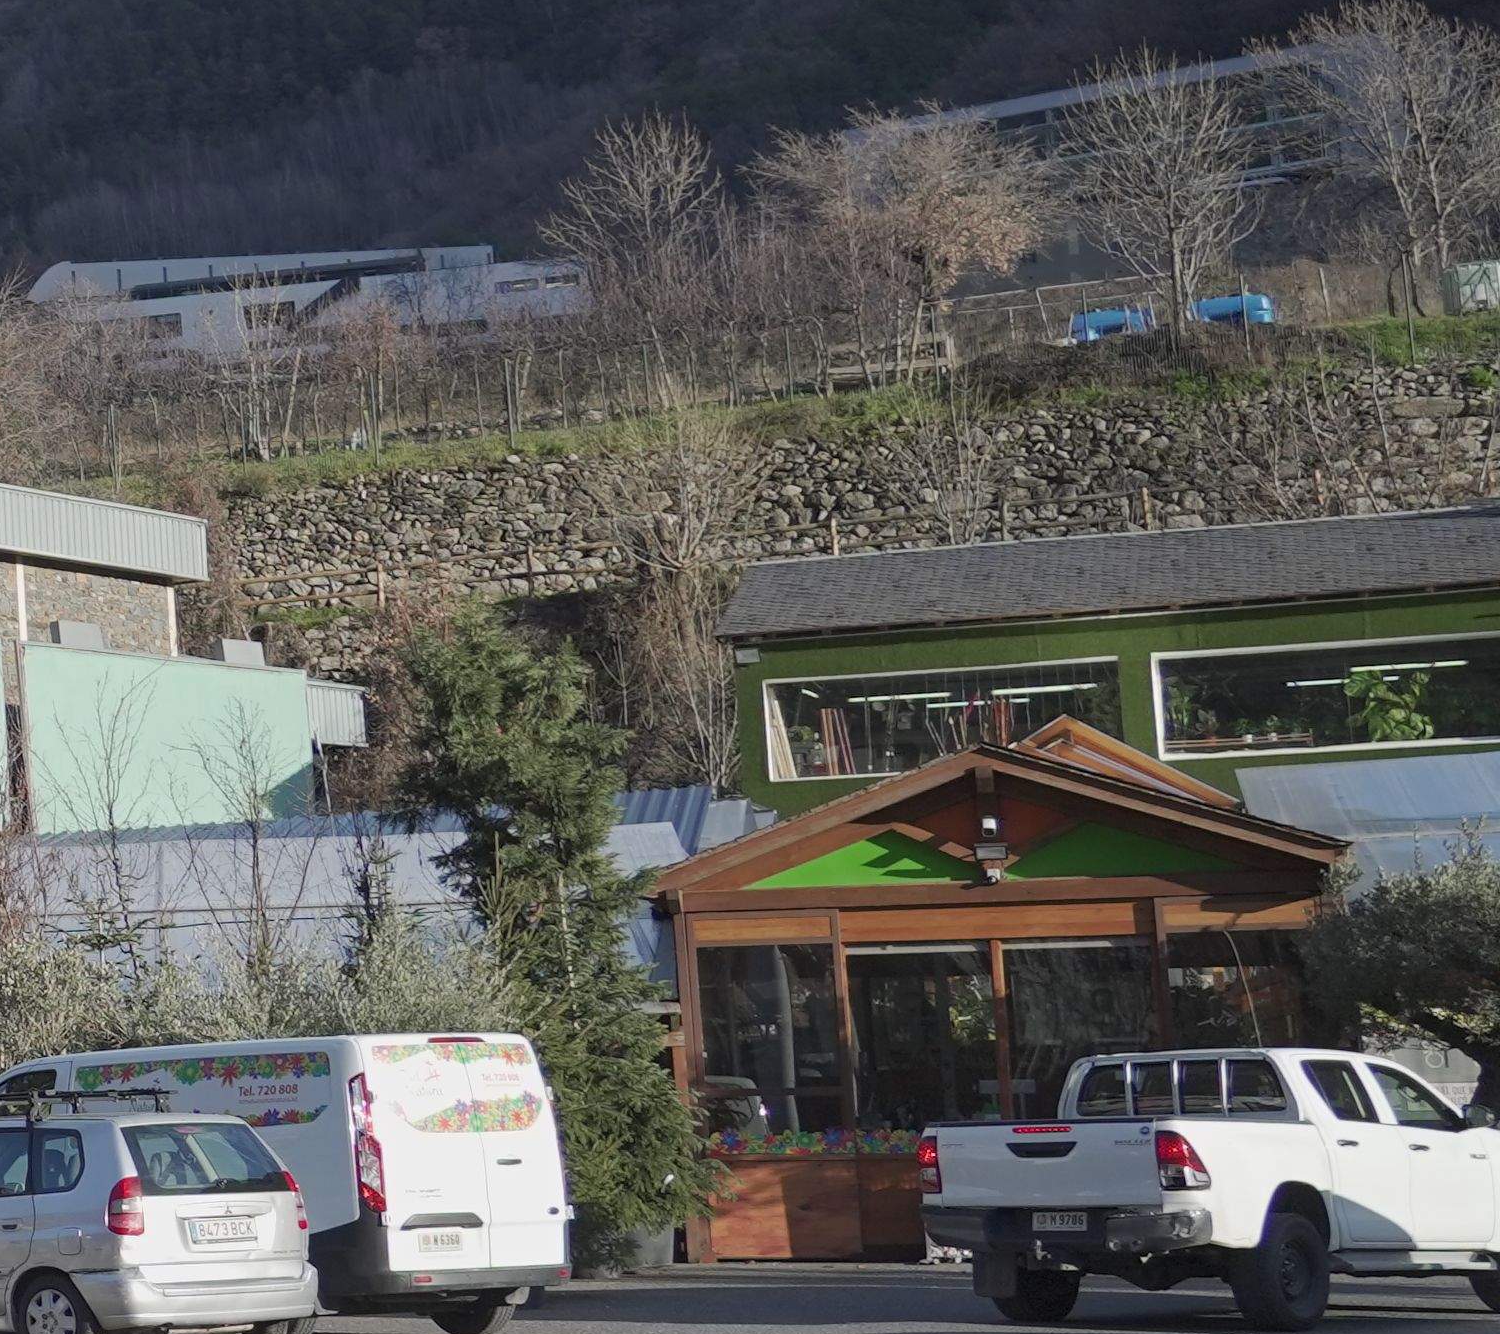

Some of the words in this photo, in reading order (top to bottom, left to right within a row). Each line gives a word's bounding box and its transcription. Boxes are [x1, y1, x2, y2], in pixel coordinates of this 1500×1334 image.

[238, 1085, 255, 1097] Tel.
[257, 1084, 276, 1095] 720
[278, 1083, 299, 1095] 808
[198, 1222, 230, 1237] 8473
[231, 1220, 254, 1236] BCK
